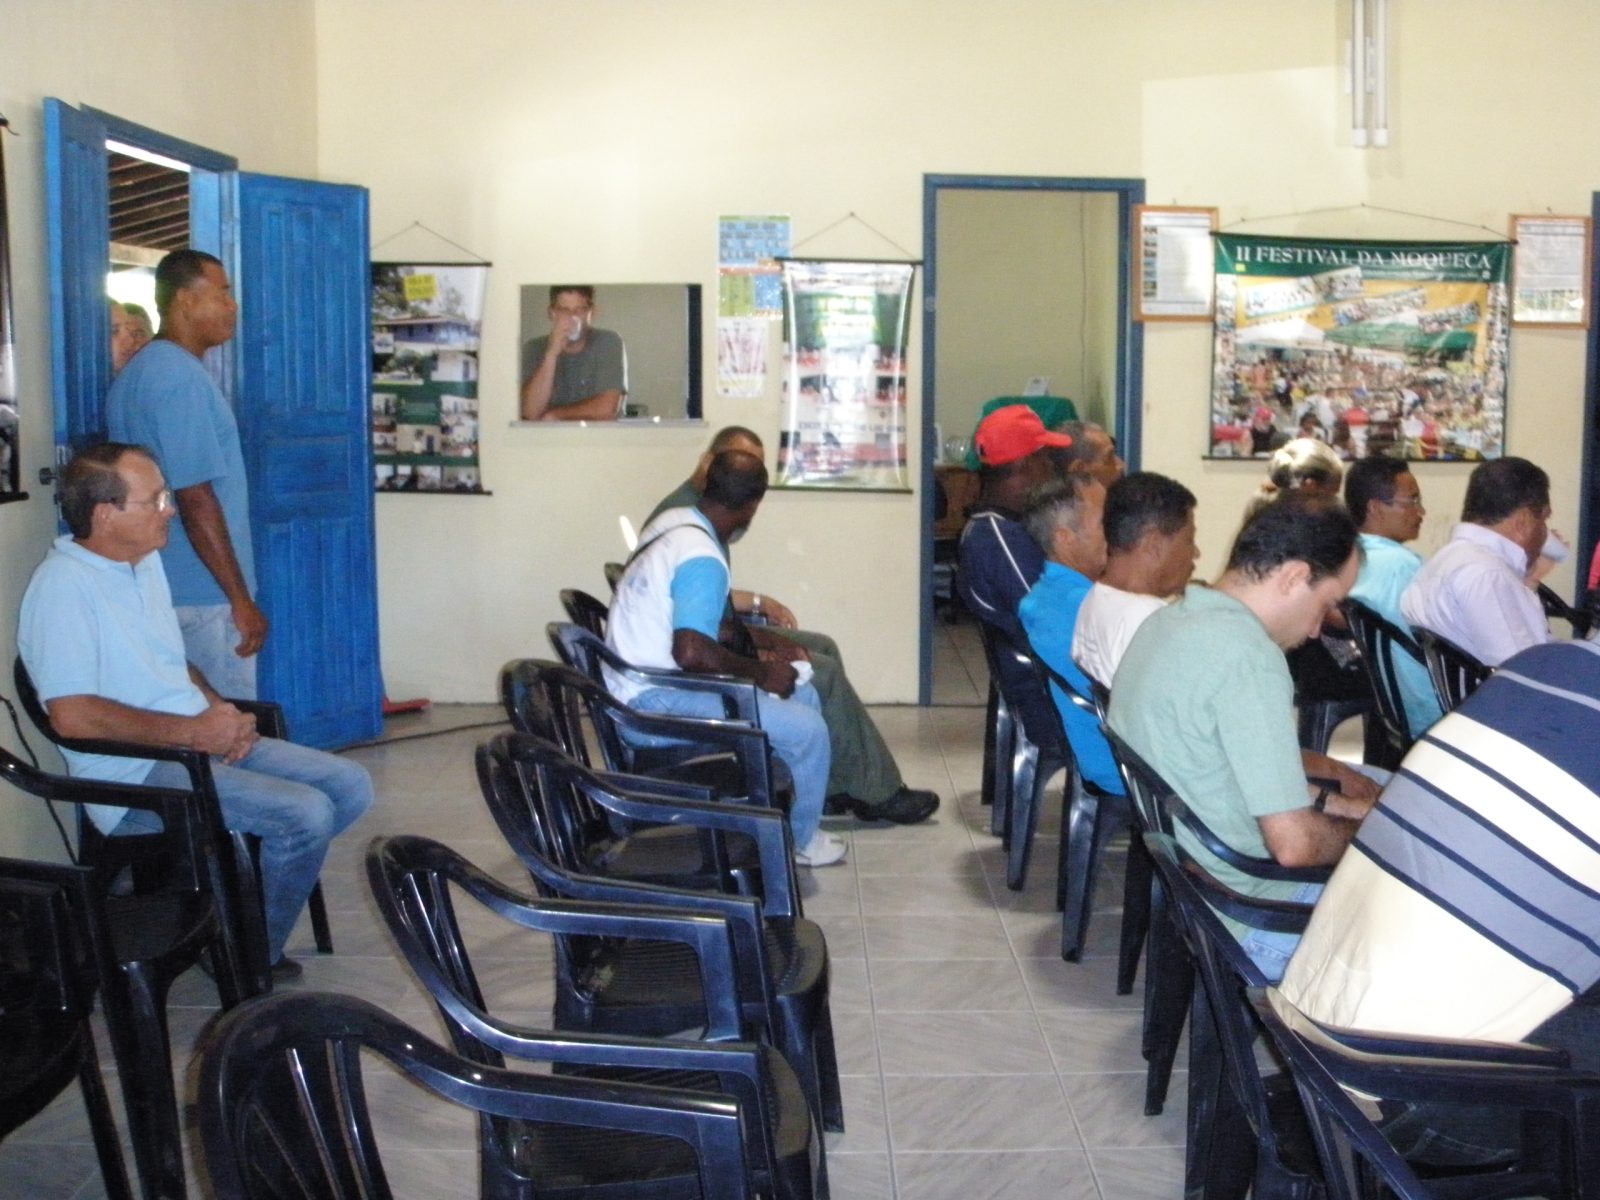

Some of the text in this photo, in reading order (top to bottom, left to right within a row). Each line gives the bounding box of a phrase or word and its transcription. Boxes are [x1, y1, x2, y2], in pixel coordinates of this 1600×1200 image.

[1236, 245, 1492, 270] II FESTIVAL DA MOQUECA
